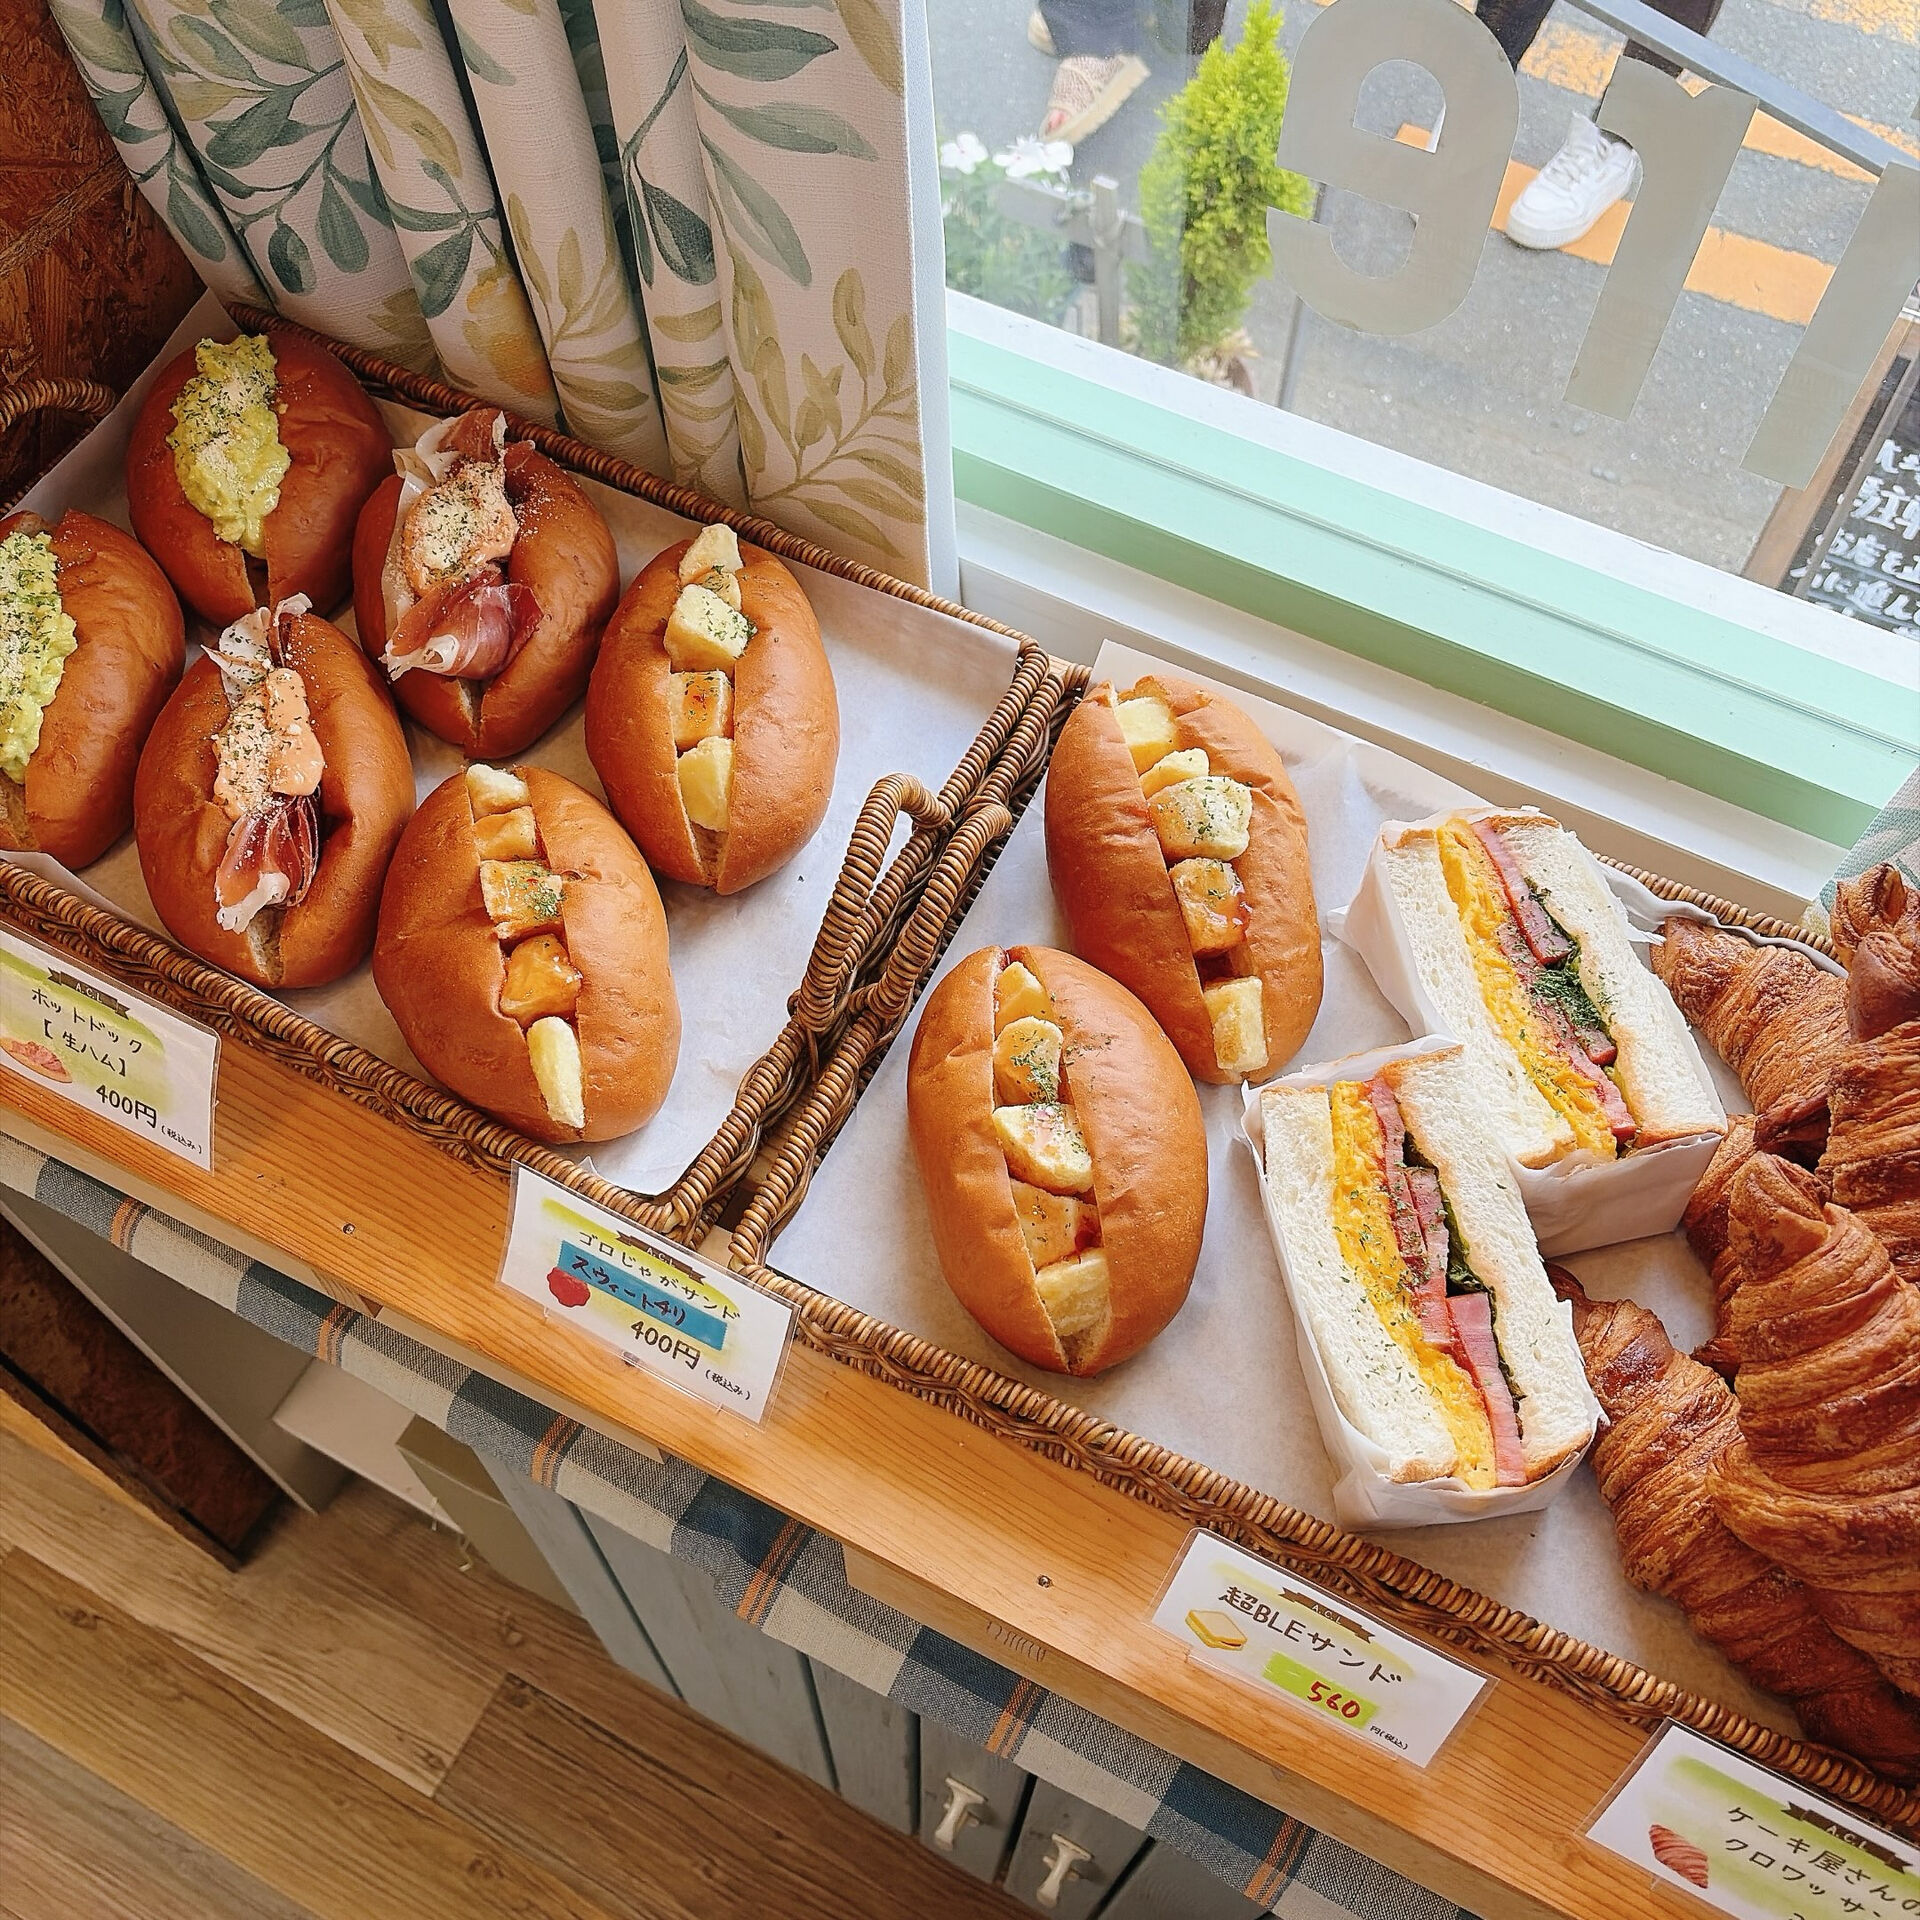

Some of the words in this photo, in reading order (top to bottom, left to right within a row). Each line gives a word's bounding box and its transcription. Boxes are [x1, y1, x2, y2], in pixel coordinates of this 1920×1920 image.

[32, 988, 142, 1053] ホットドック
[44, 1019, 127, 1077] 【生ハム】
[96, 1084, 157, 1128] 400円
[579, 1231, 740, 1320] ゴロじゃがサンド
[631, 1320, 701, 1370] 400円
[1218, 1586, 1402, 1684] 超BLEサンド
[1307, 1681, 1361, 1719] 560
[1725, 1838, 1881, 1918] クロワッサ
